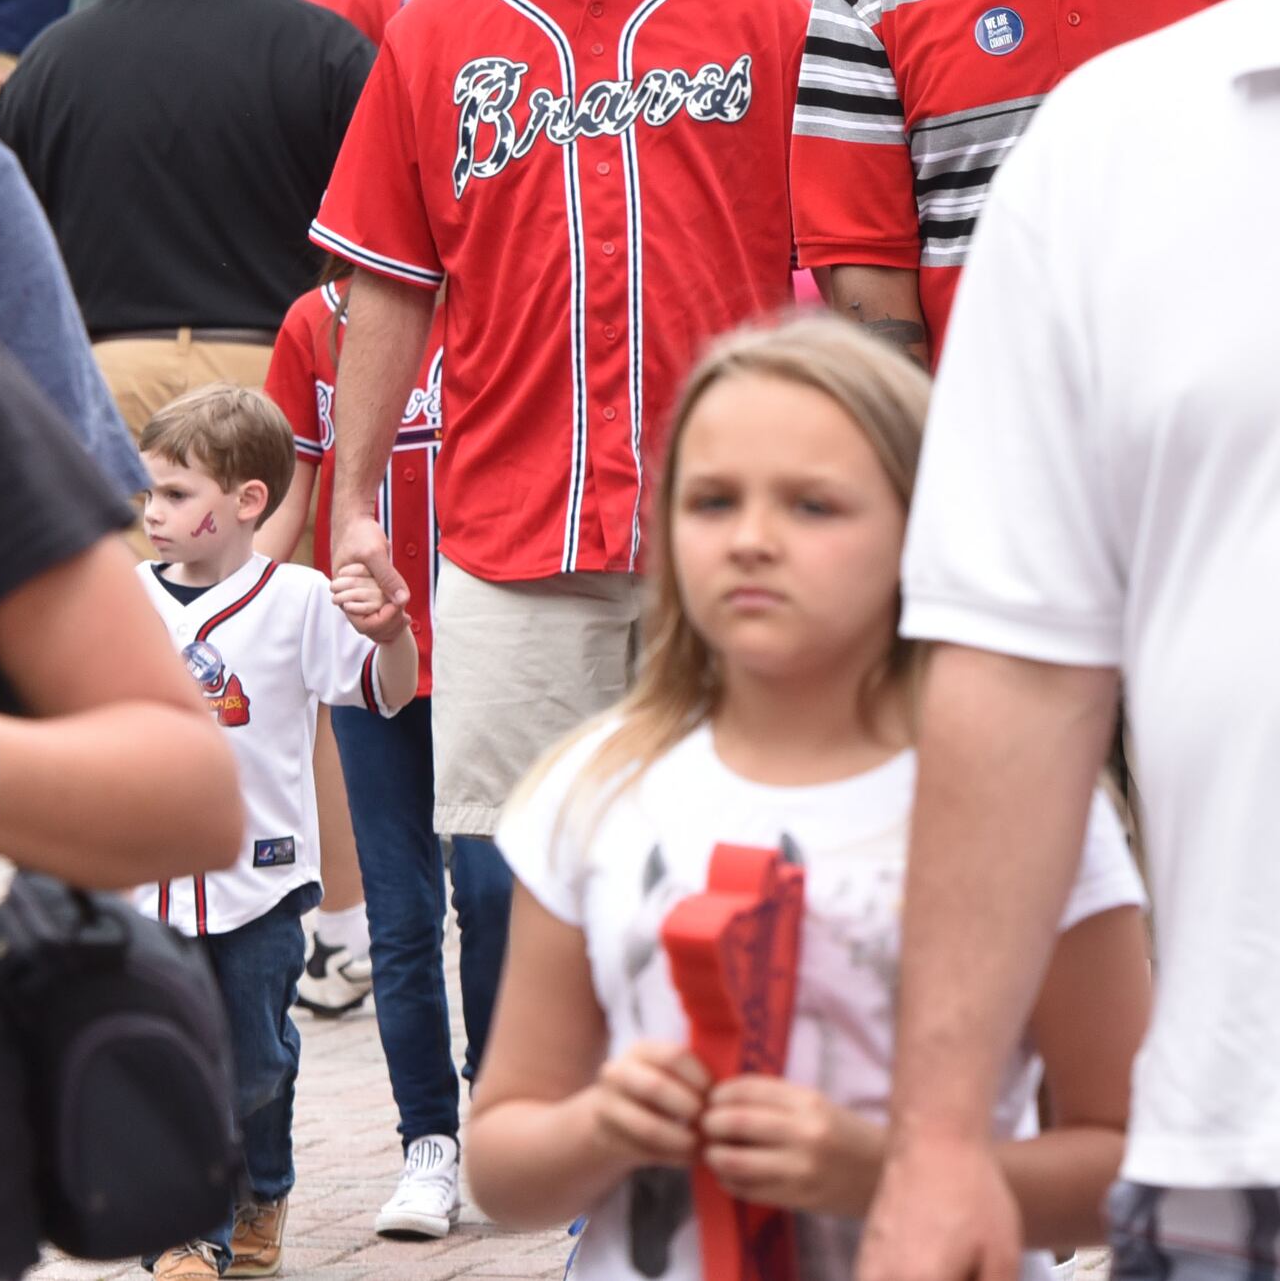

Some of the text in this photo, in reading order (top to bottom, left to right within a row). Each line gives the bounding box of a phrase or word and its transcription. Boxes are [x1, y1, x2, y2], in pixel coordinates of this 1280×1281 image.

[984, 13, 1009, 30] WE ARE
[453, 54, 752, 200] Braves
